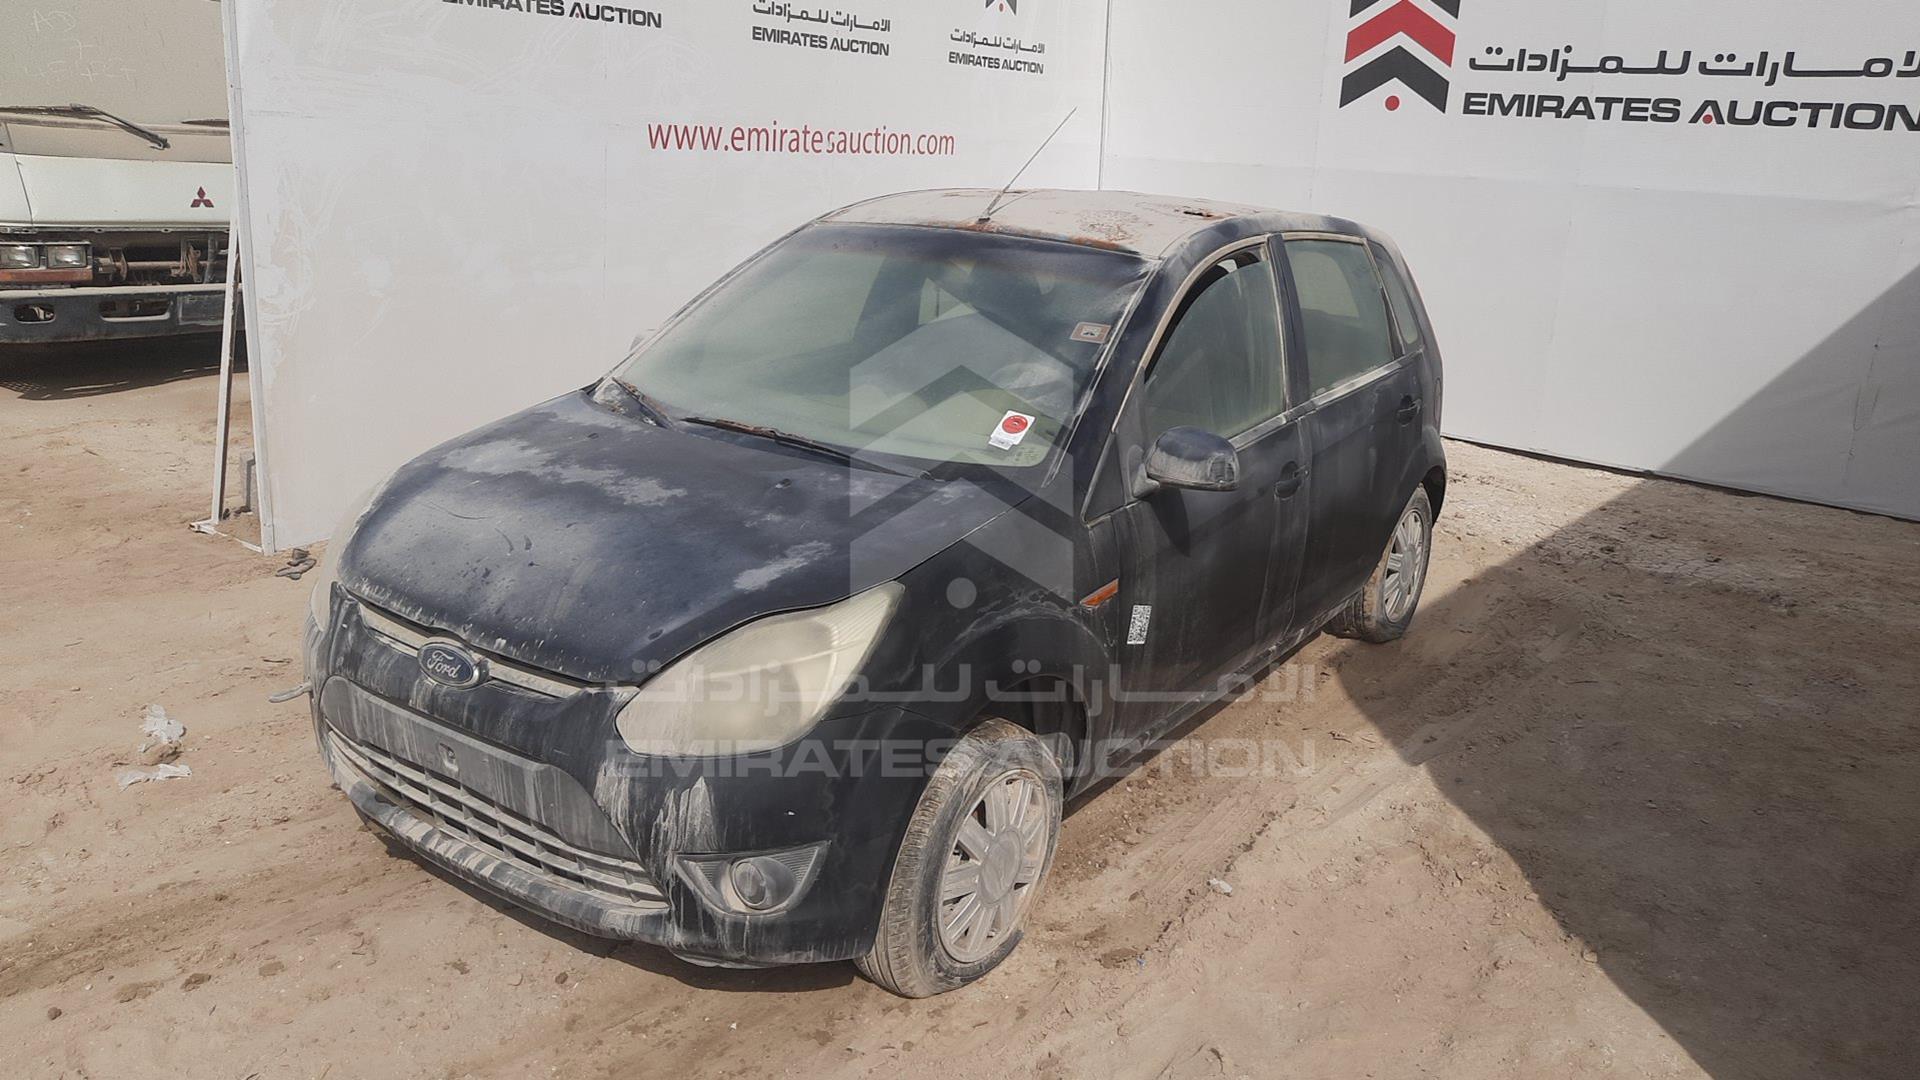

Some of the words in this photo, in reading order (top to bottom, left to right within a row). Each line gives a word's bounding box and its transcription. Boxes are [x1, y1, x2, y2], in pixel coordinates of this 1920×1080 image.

[568, 2, 663, 28] AUCTION
[752, 26, 828, 49] EMIRATES
[829, 37, 890, 56] AUCTION
[948, 51, 1000, 69] EMIRATES
[1001, 58, 1044, 74] AUCTION
[1462, 92, 1682, 123] EMIRATES
[1688, 100, 1920, 132] AUCTION
[647, 120, 955, 156] www.emiratesauction.com
[427, 650, 461, 678] Ford
